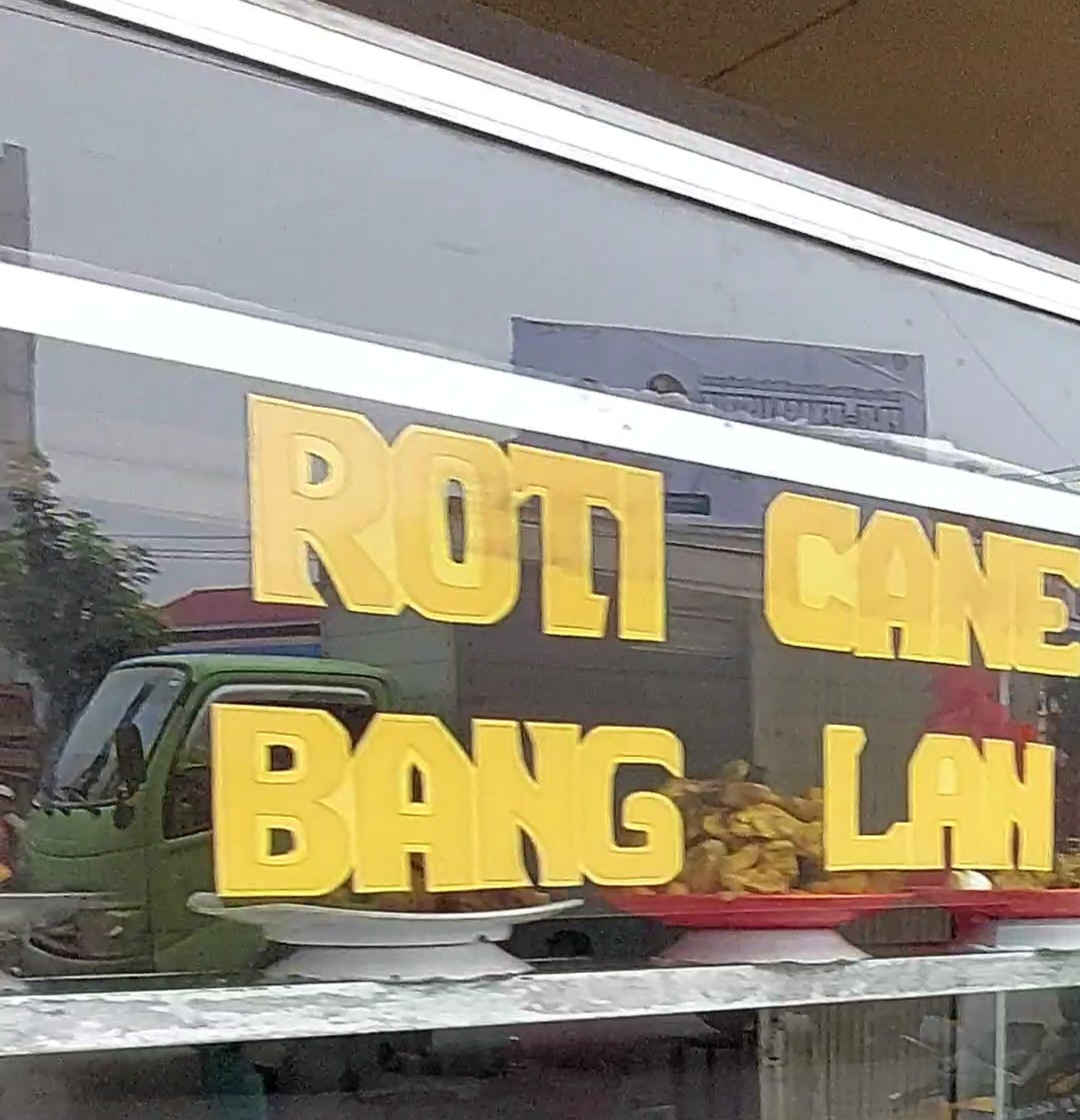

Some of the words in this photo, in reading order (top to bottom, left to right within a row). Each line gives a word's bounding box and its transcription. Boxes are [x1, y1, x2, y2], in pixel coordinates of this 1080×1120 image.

[247, 392, 667, 642] ROTI
[210, 702, 686, 898] BANG
[822, 724, 1056, 872] LAN
